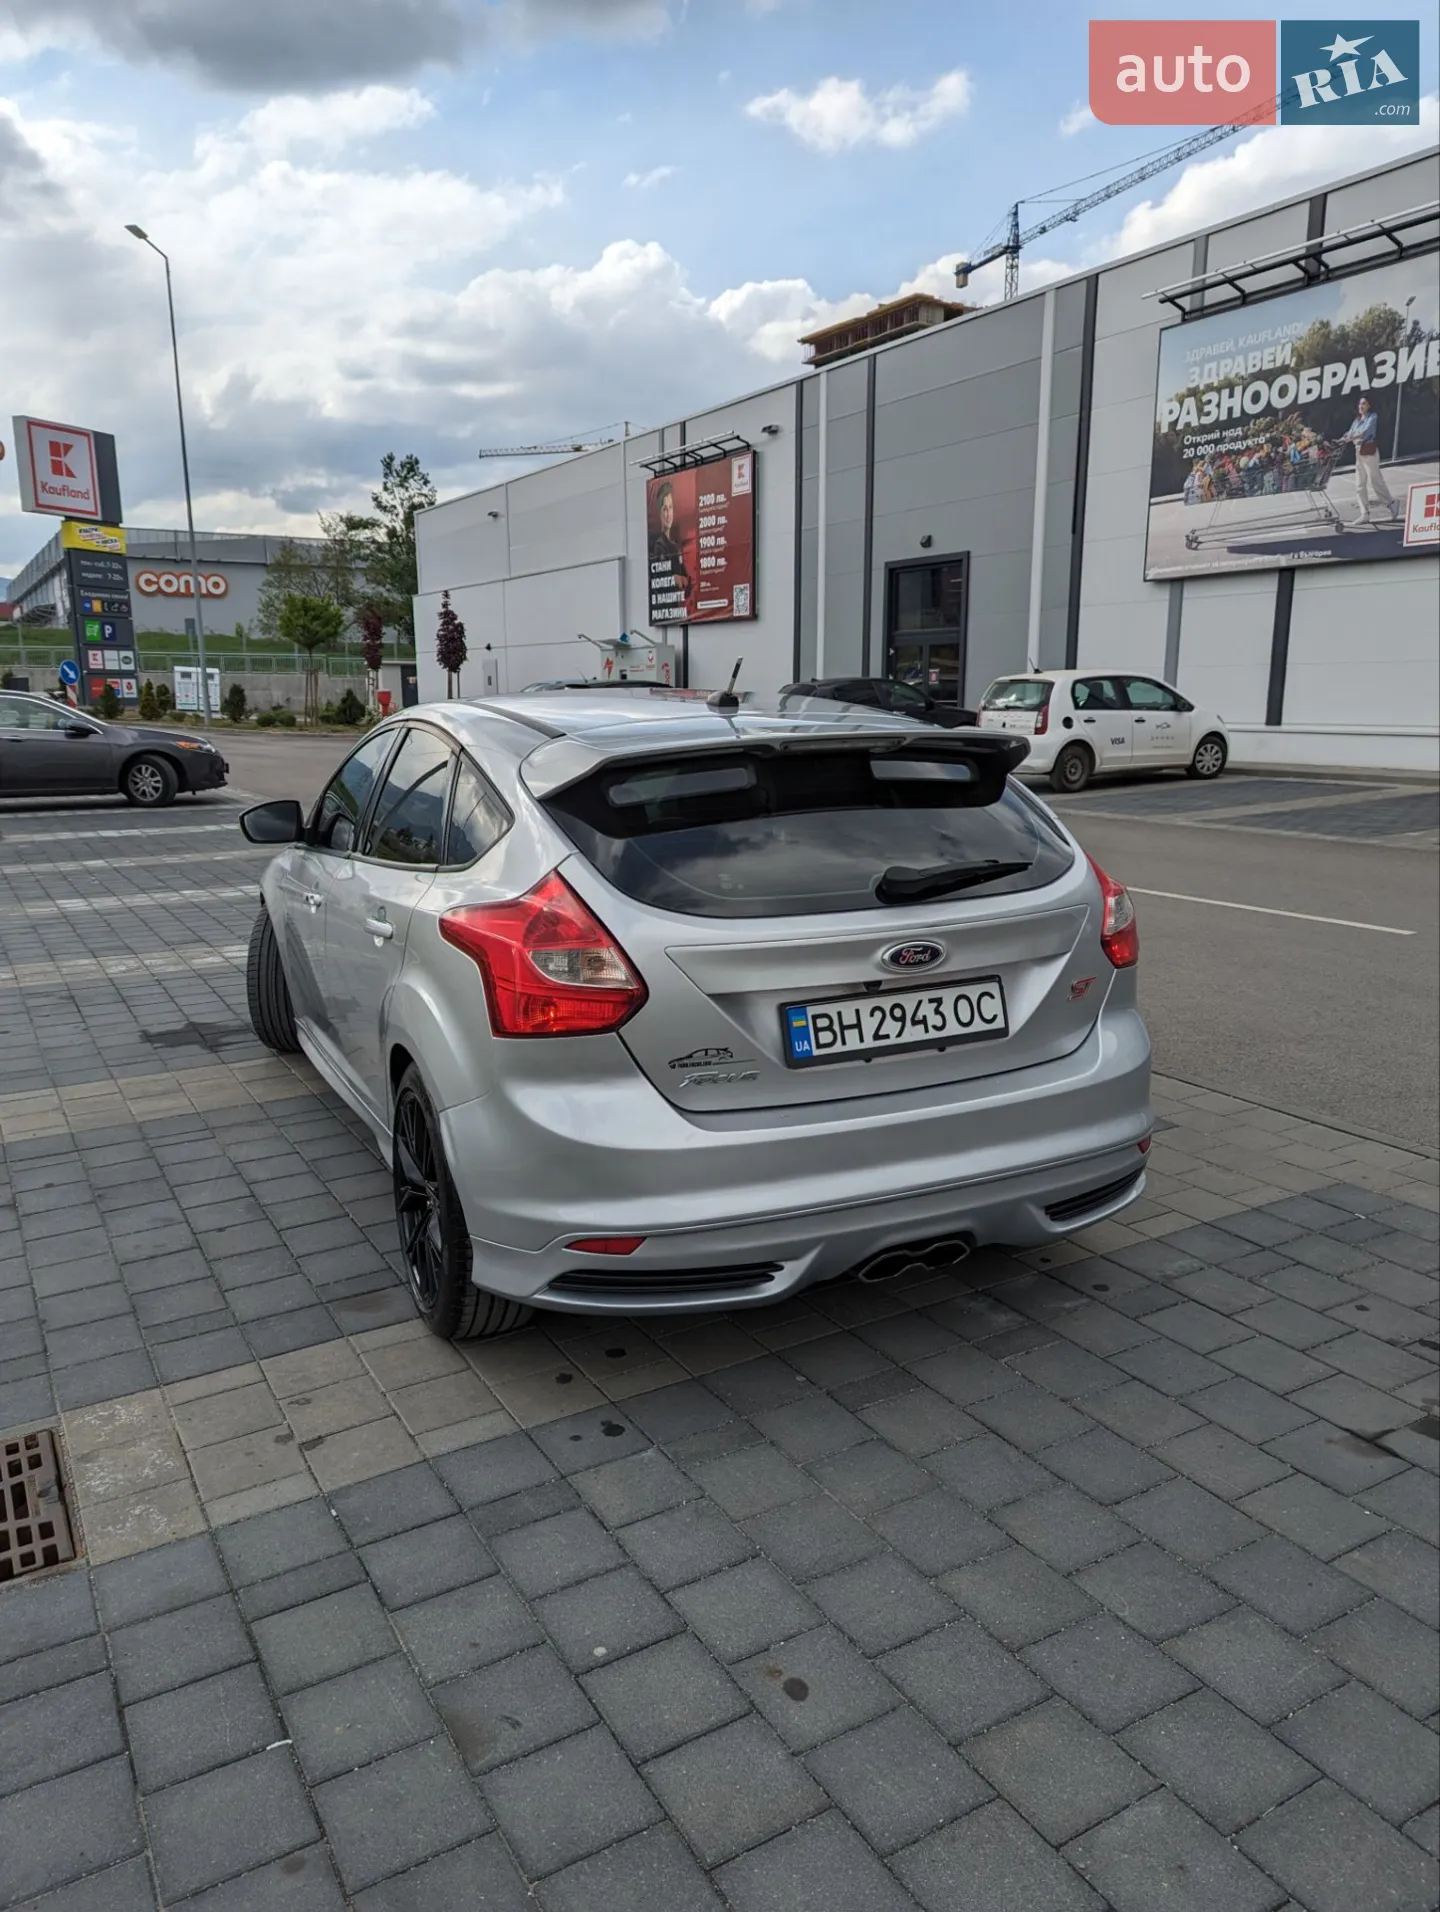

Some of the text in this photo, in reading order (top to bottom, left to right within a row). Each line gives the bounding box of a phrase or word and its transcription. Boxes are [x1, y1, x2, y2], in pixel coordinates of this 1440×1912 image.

[1188, 338, 1297, 389] ЗДРАВЕЙ,
[1183, 426, 1243, 445] Открий над
[1182, 447, 1195, 459] 20
[1196, 443, 1215, 456] 000
[40, 480, 91, 501] Kaufland
[699, 493, 715, 507] 2100
[699, 515, 716, 529] 2000
[700, 535, 715, 549] 1900
[651, 560, 672, 574] СТАНИ
[138, 573, 226, 596] como
[651, 576, 676, 589] КОЛЕГА
[651, 591, 686, 605] В НАШИТЕ
[651, 607, 688, 621] МАГАЗИНИ
[1111, 737, 1126, 746] VISA
[898, 946, 931, 965] Ford
[1070, 976, 1098, 1000] ST
[811, 991, 998, 1050] BH 2943 OC
[795, 1039, 809, 1054] UA
